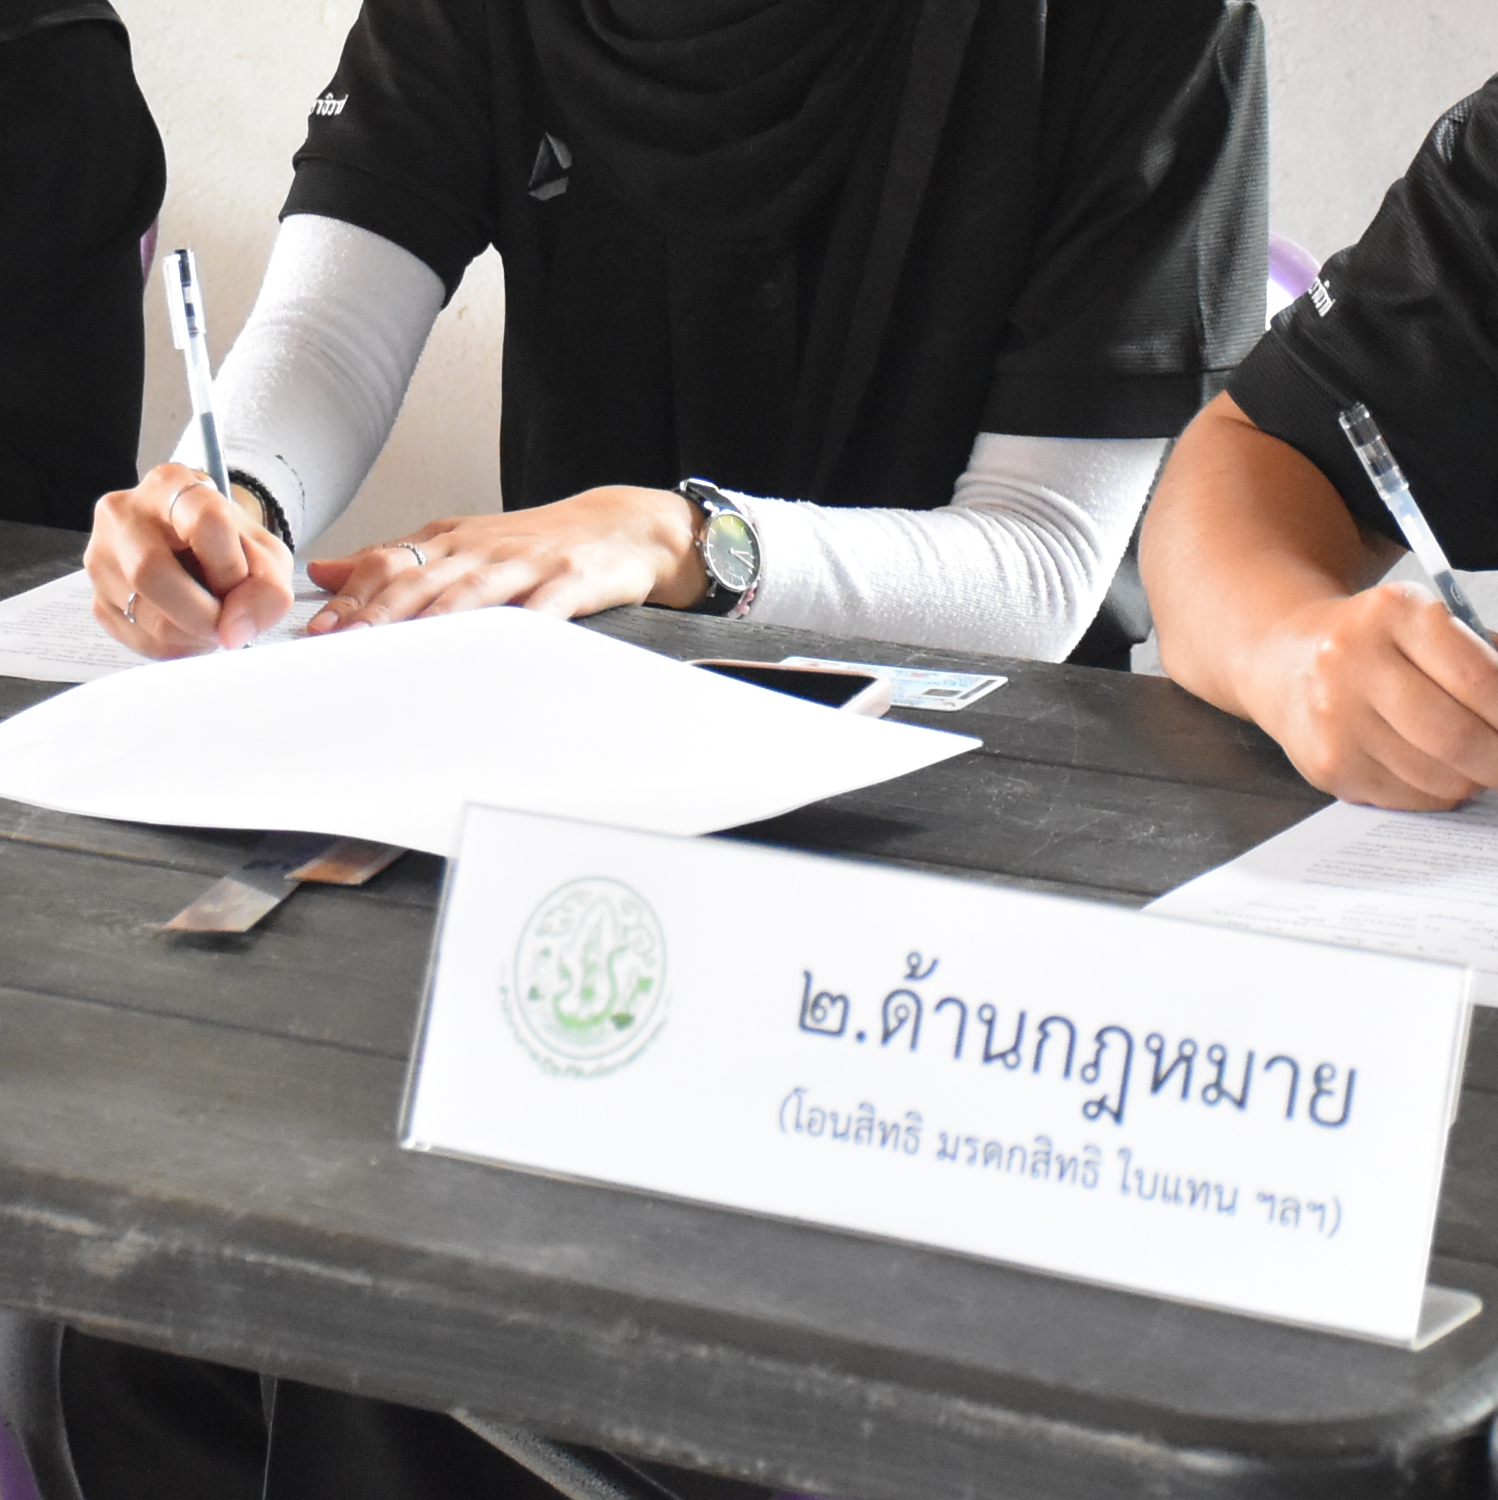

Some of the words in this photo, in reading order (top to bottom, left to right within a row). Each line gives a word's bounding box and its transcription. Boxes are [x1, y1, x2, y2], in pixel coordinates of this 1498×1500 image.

[798, 950, 1358, 1129] ๒.ด้านกฎหมาย
[777, 1086, 923, 1156] (โอนสิทธิ
[935, 1131, 1103, 1191] มรดกสิทธิ
[1117, 1147, 1239, 1217] ใบแทน
